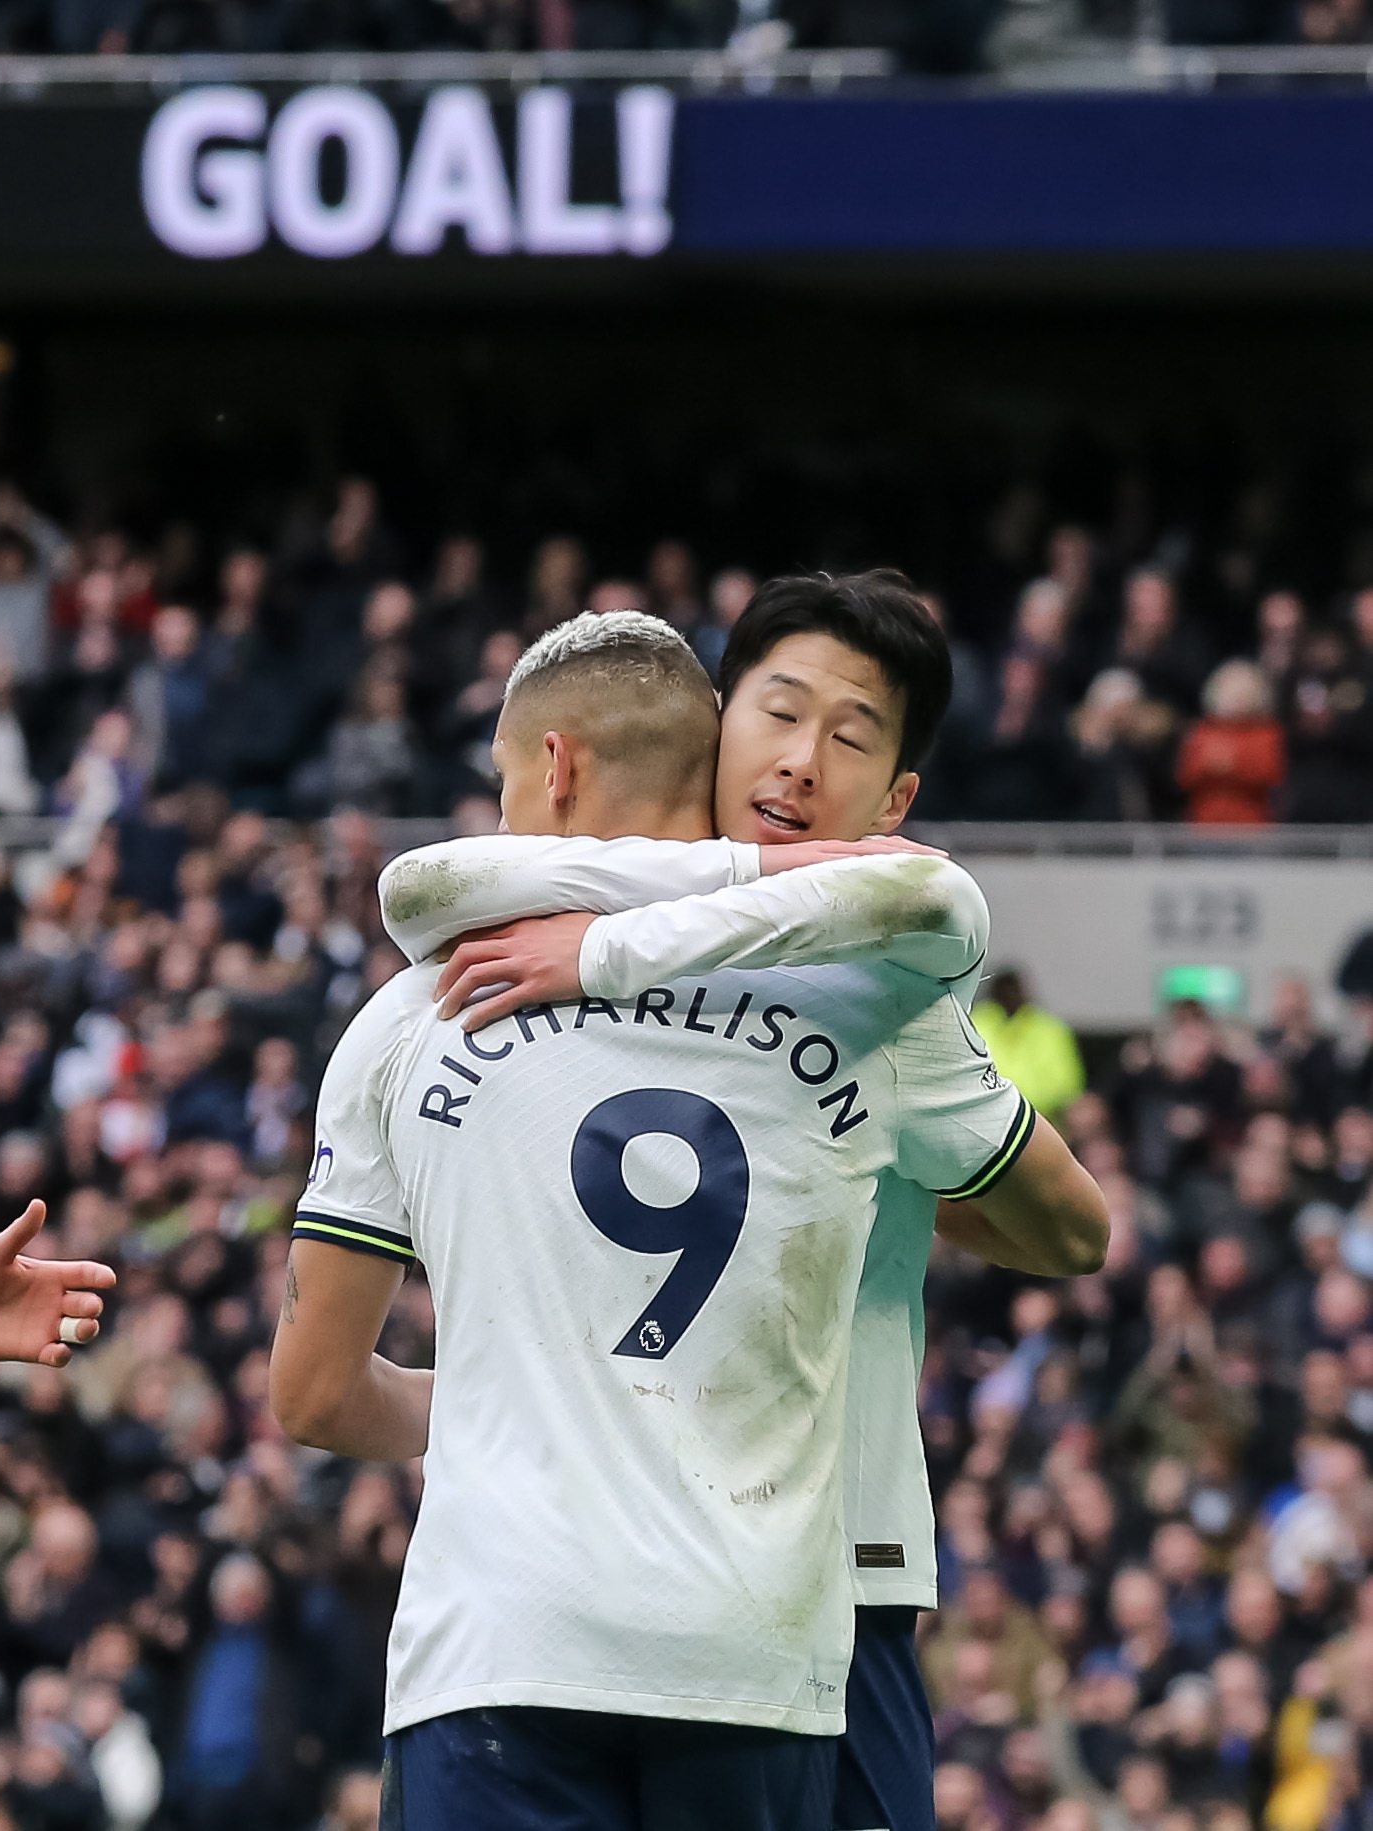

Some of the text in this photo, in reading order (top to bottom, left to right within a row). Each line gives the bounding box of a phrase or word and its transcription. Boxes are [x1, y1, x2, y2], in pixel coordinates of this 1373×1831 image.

[142, 86, 673, 256] GOAL!
[417, 986, 870, 1140] RICHARLISON
[569, 1086, 750, 1360] 9
